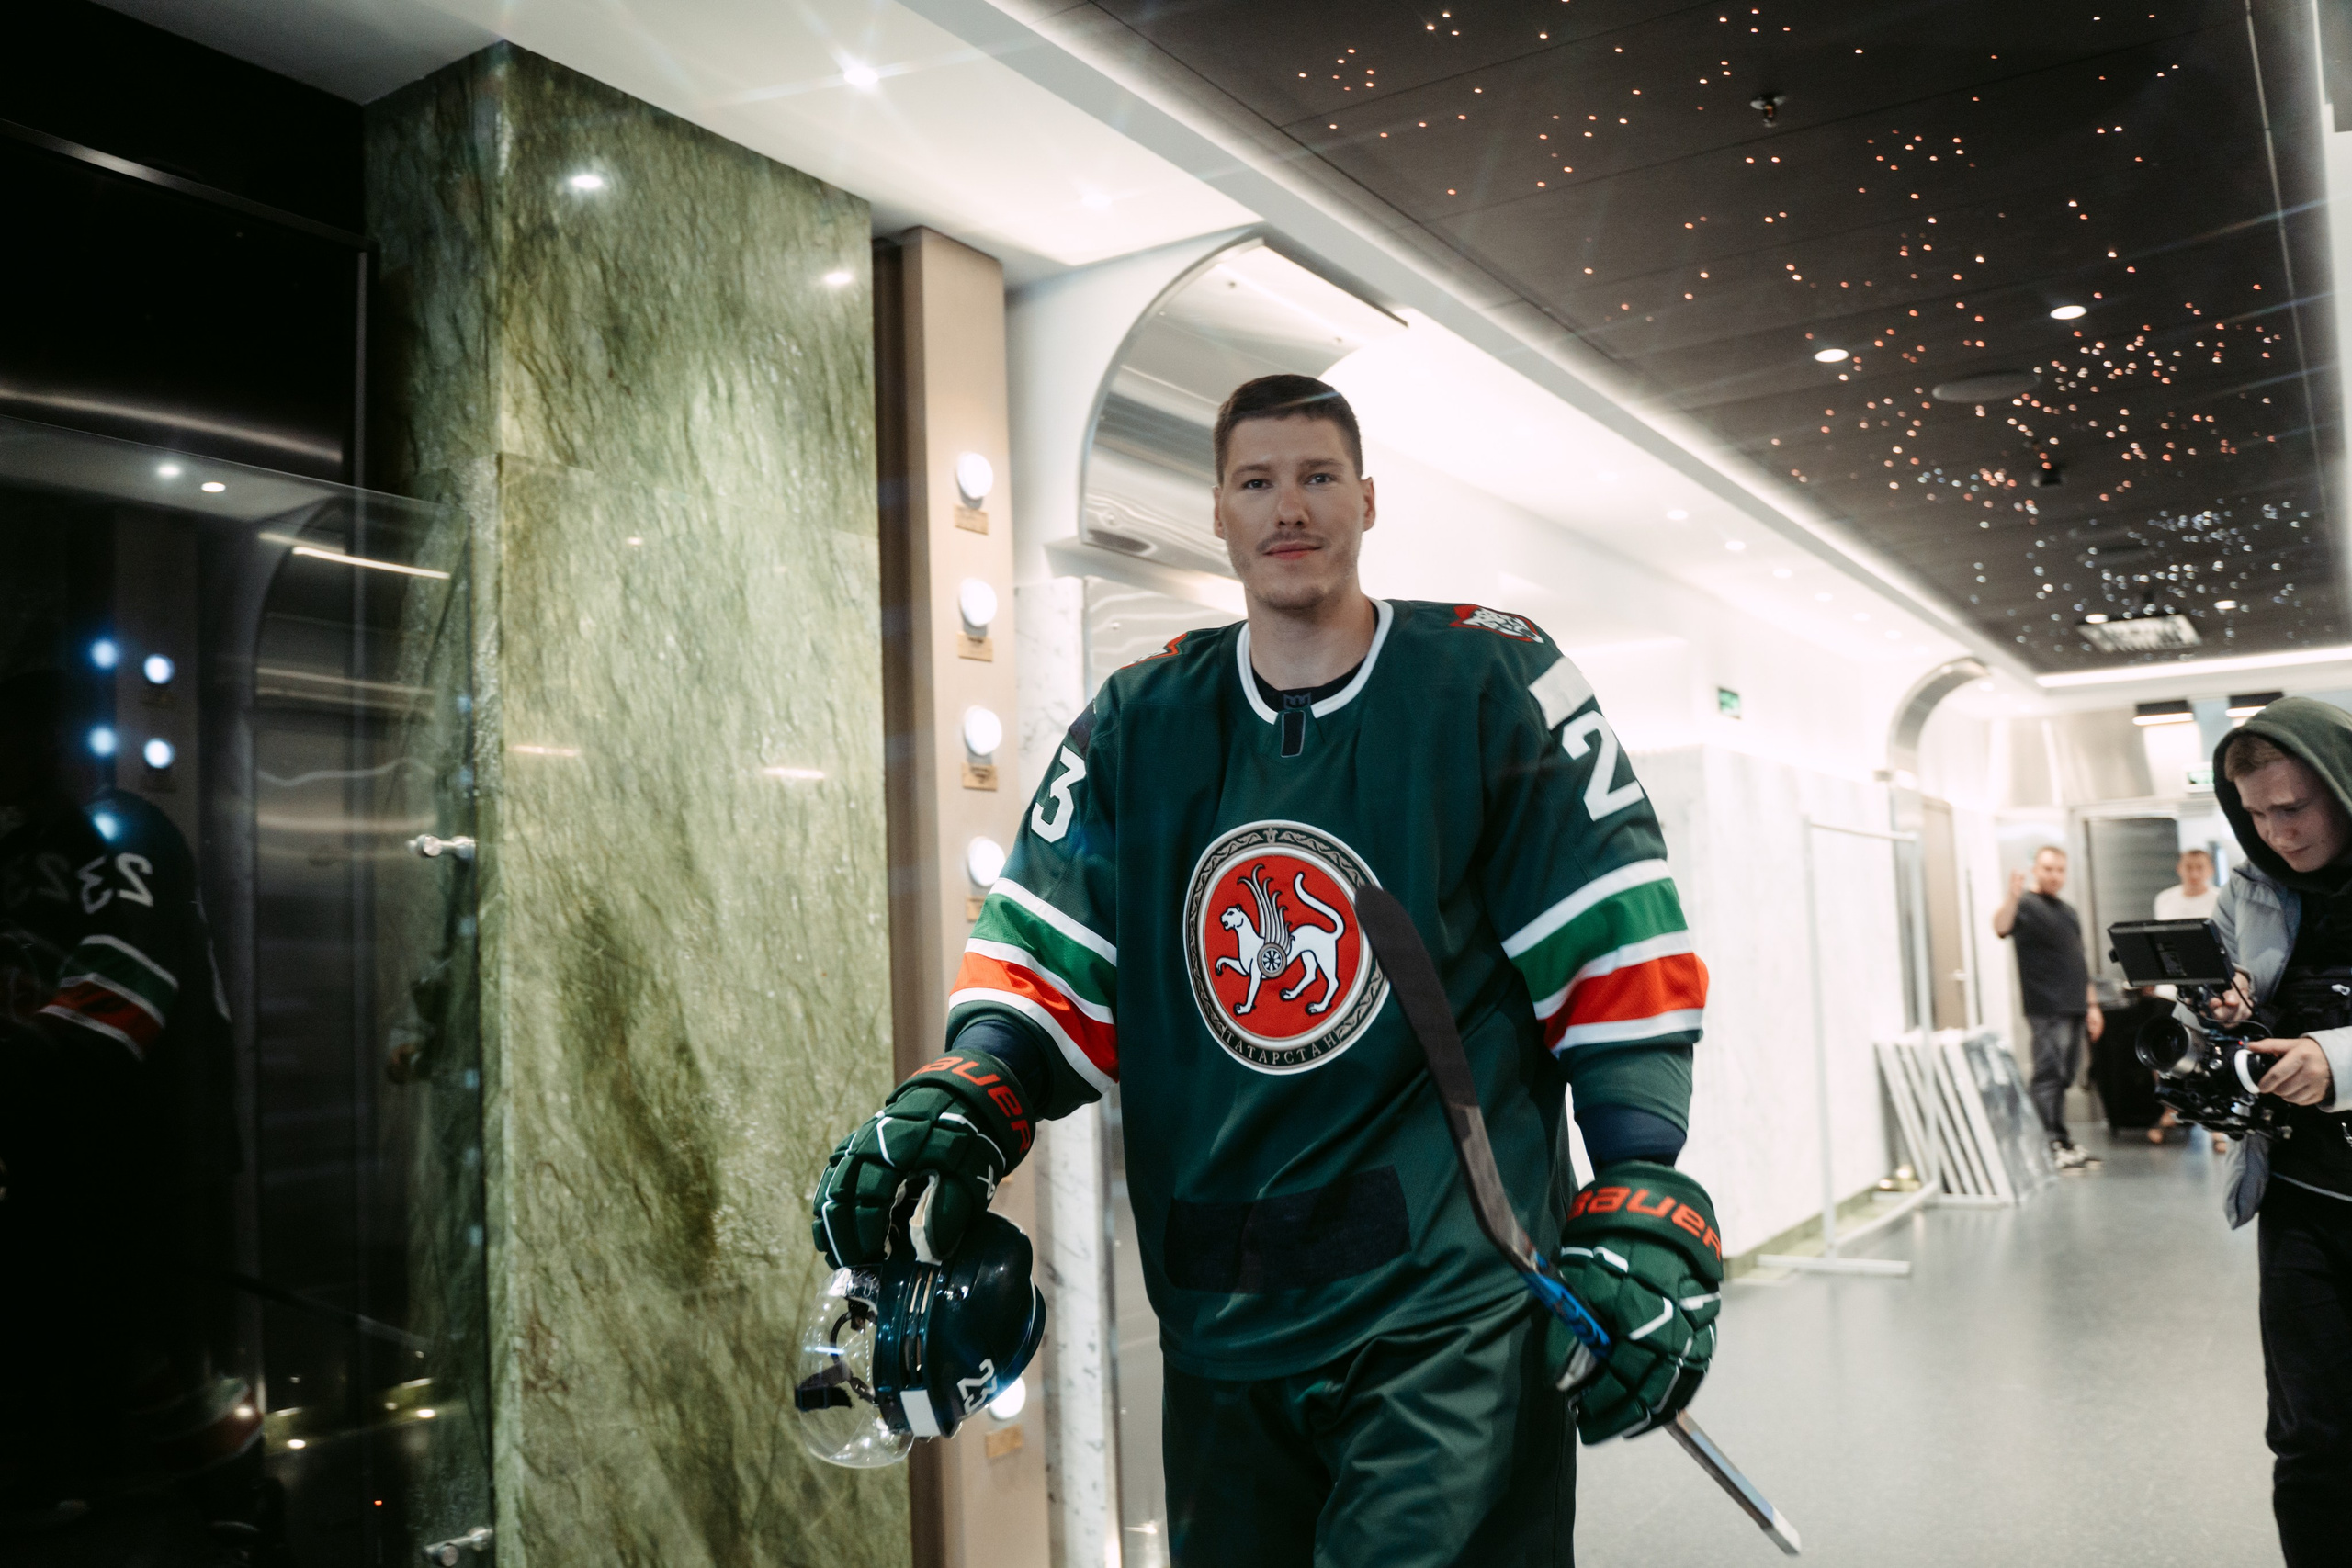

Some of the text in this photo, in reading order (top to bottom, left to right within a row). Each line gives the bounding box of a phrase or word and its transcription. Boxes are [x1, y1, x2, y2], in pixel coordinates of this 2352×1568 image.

[1031, 745, 1087, 843] 3
[1562, 709, 1645, 821] 2
[1225, 1030, 1337, 1065] ТАТАРСТАН
[908, 1056, 1031, 1155] AUER
[956, 1358, 998, 1415] 23
